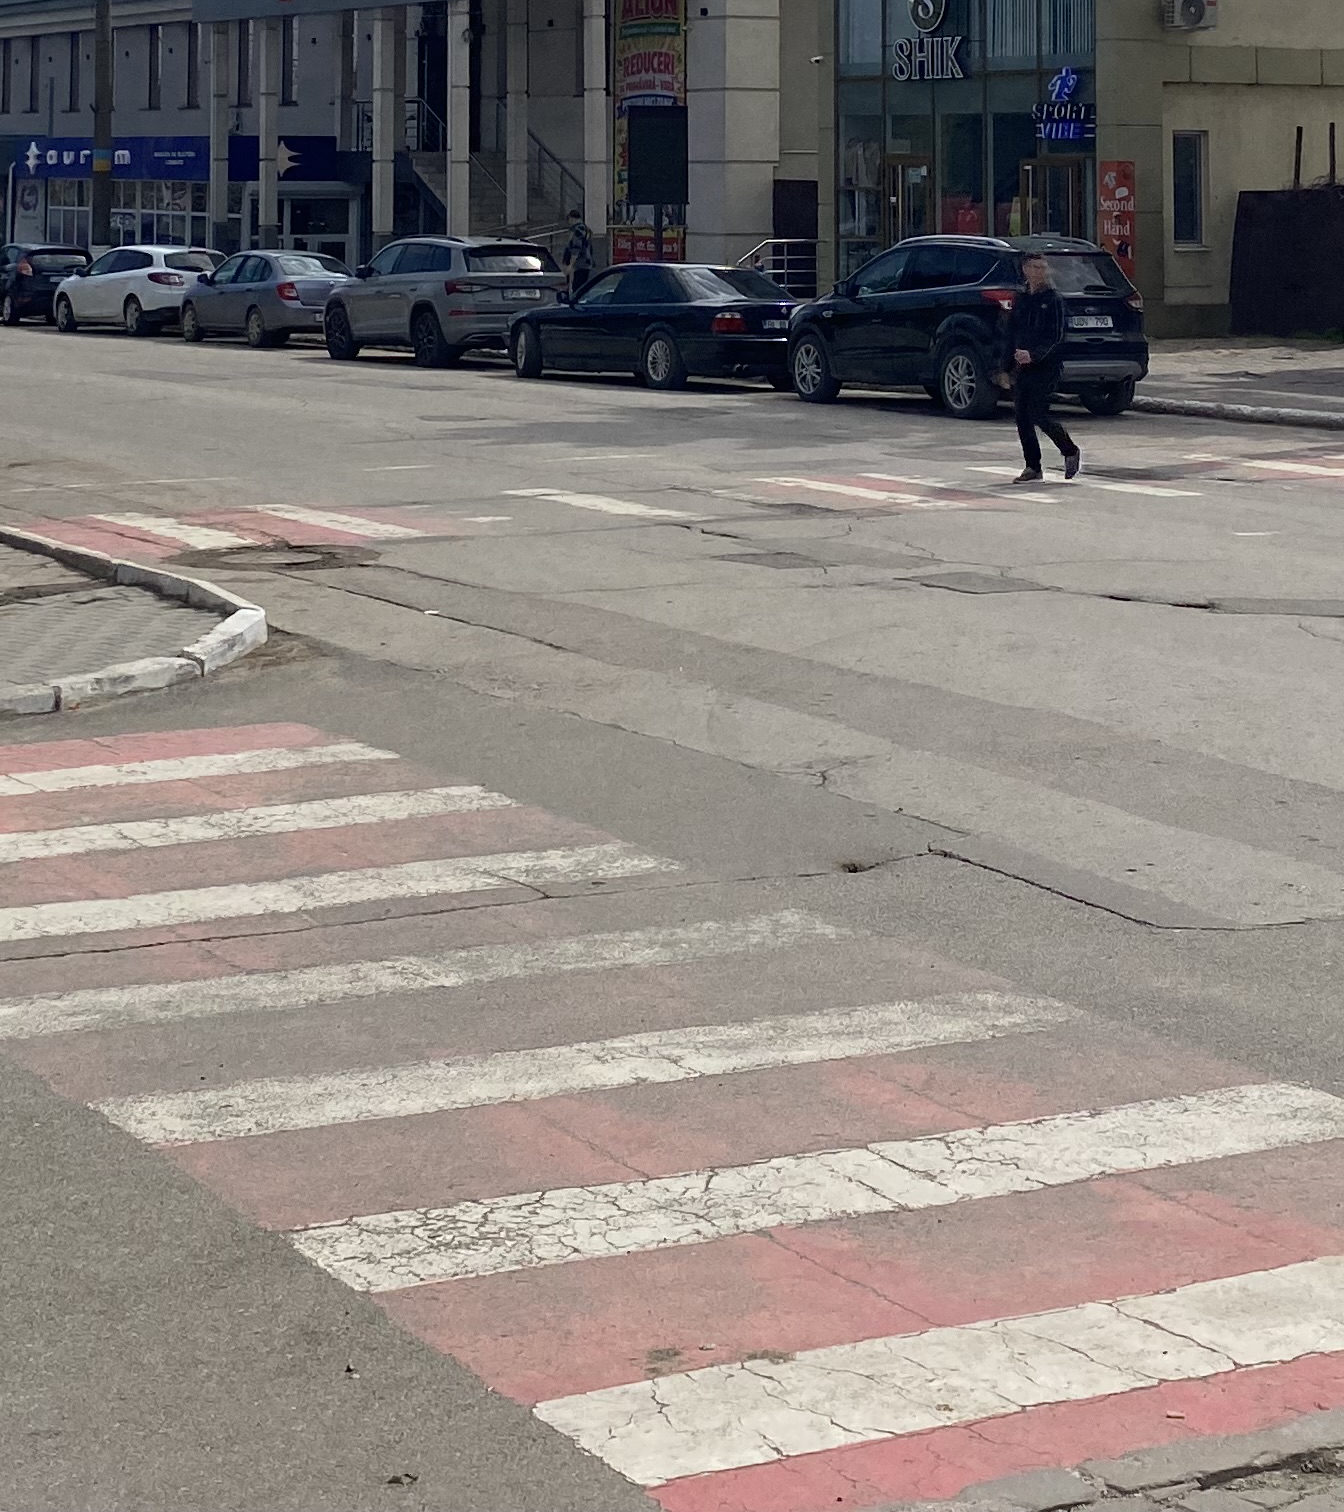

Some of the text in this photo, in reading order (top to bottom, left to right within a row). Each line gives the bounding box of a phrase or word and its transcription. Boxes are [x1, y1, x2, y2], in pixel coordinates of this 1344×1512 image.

[623, 51, 675, 78] REDUCERI
[892, 36, 964, 80] SHIK
[1100, 196, 1134, 211] Second
[1103, 220, 1131, 236] Hand
